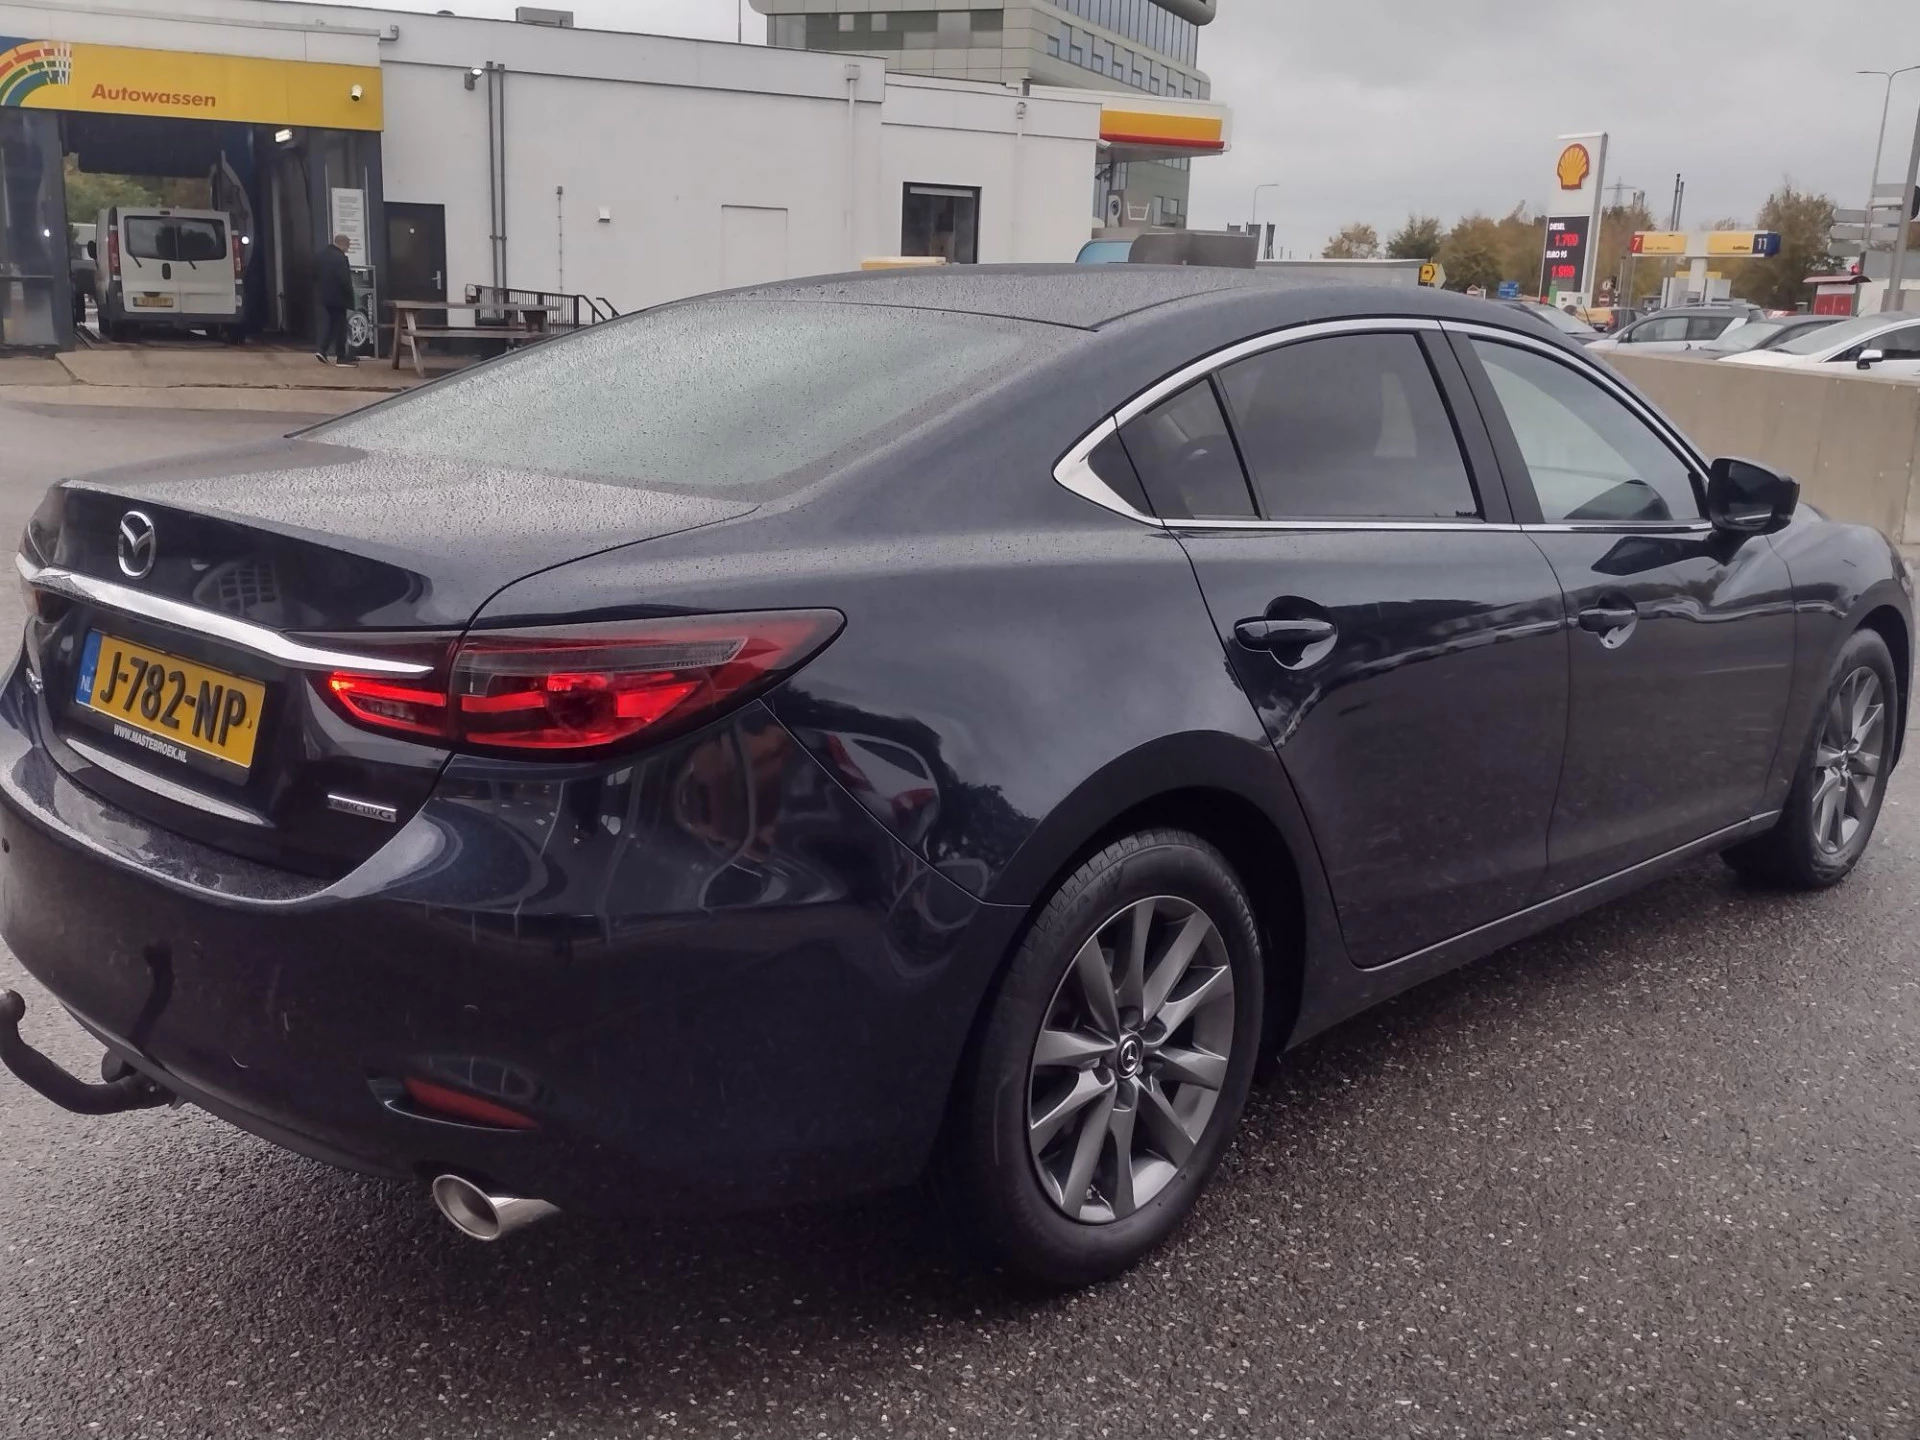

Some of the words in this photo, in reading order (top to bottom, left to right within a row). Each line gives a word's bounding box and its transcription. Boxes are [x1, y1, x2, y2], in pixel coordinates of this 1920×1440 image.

[91, 83, 216, 107] Autowassen
[1633, 237, 1640, 250] 7
[1757, 237, 1767, 249] 11
[1560, 250, 1567, 258] 95
[80, 674, 92, 693] NL
[100, 652, 247, 747] J-782-NP
[113, 723, 187, 763] WWW.MASTEBROEK.NL
